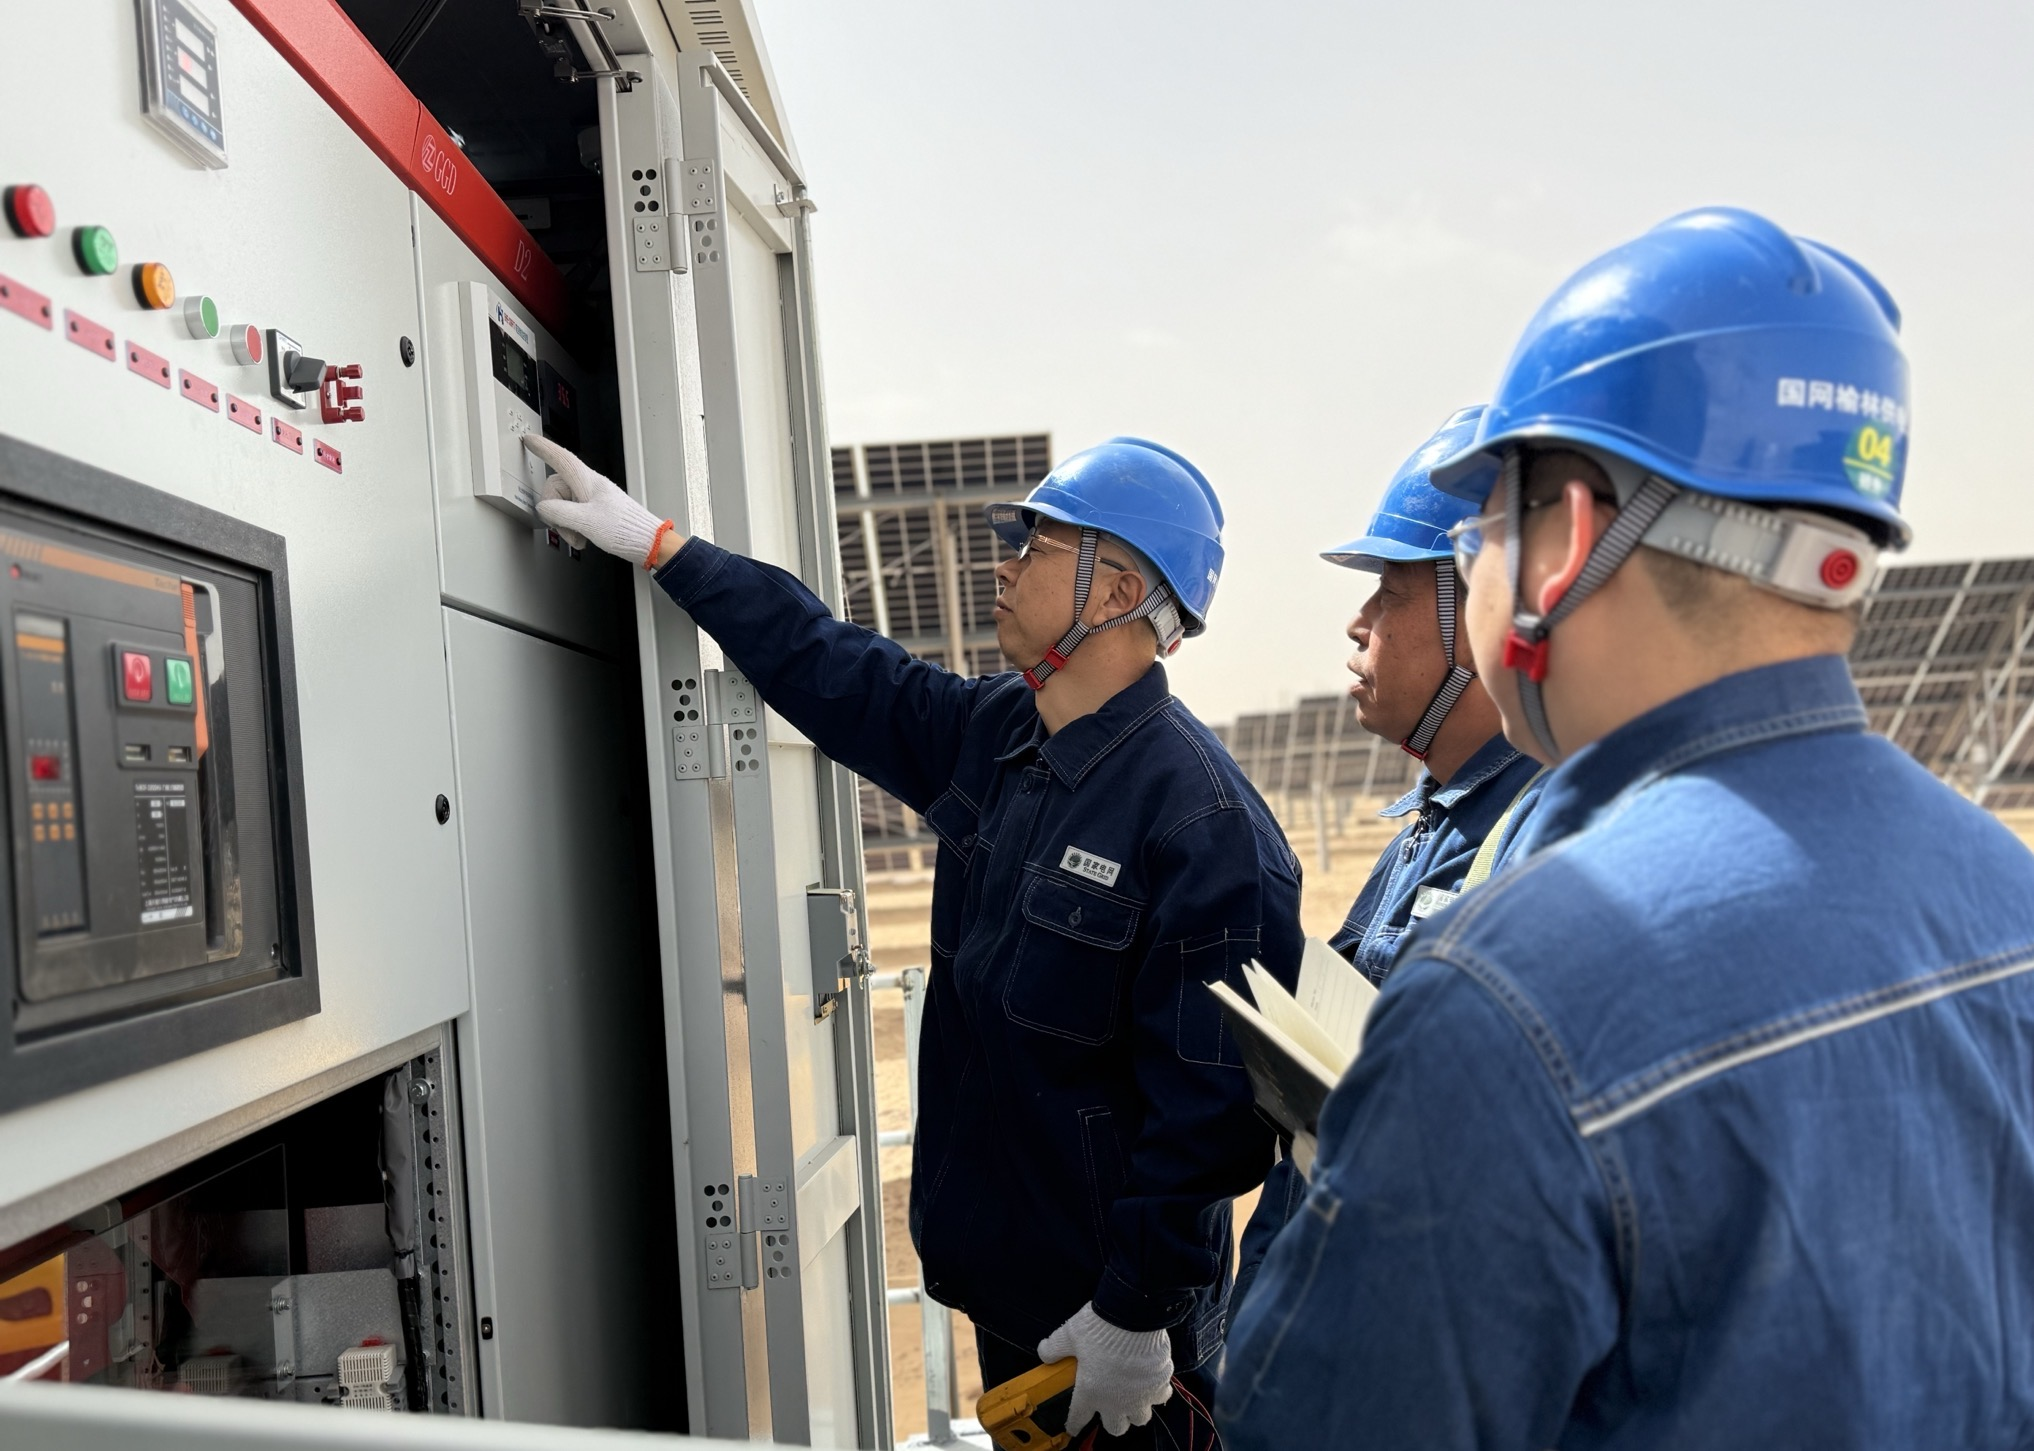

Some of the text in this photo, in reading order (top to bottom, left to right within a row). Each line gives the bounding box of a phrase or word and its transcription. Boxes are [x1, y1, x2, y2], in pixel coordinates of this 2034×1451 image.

[434, 150, 457, 196] GGD
[513, 239, 532, 281] D2
[1777, 377, 1907, 433] 国网榆林
[1857, 426, 1892, 468] 04
[1083, 857, 1115, 876] 国家电网
